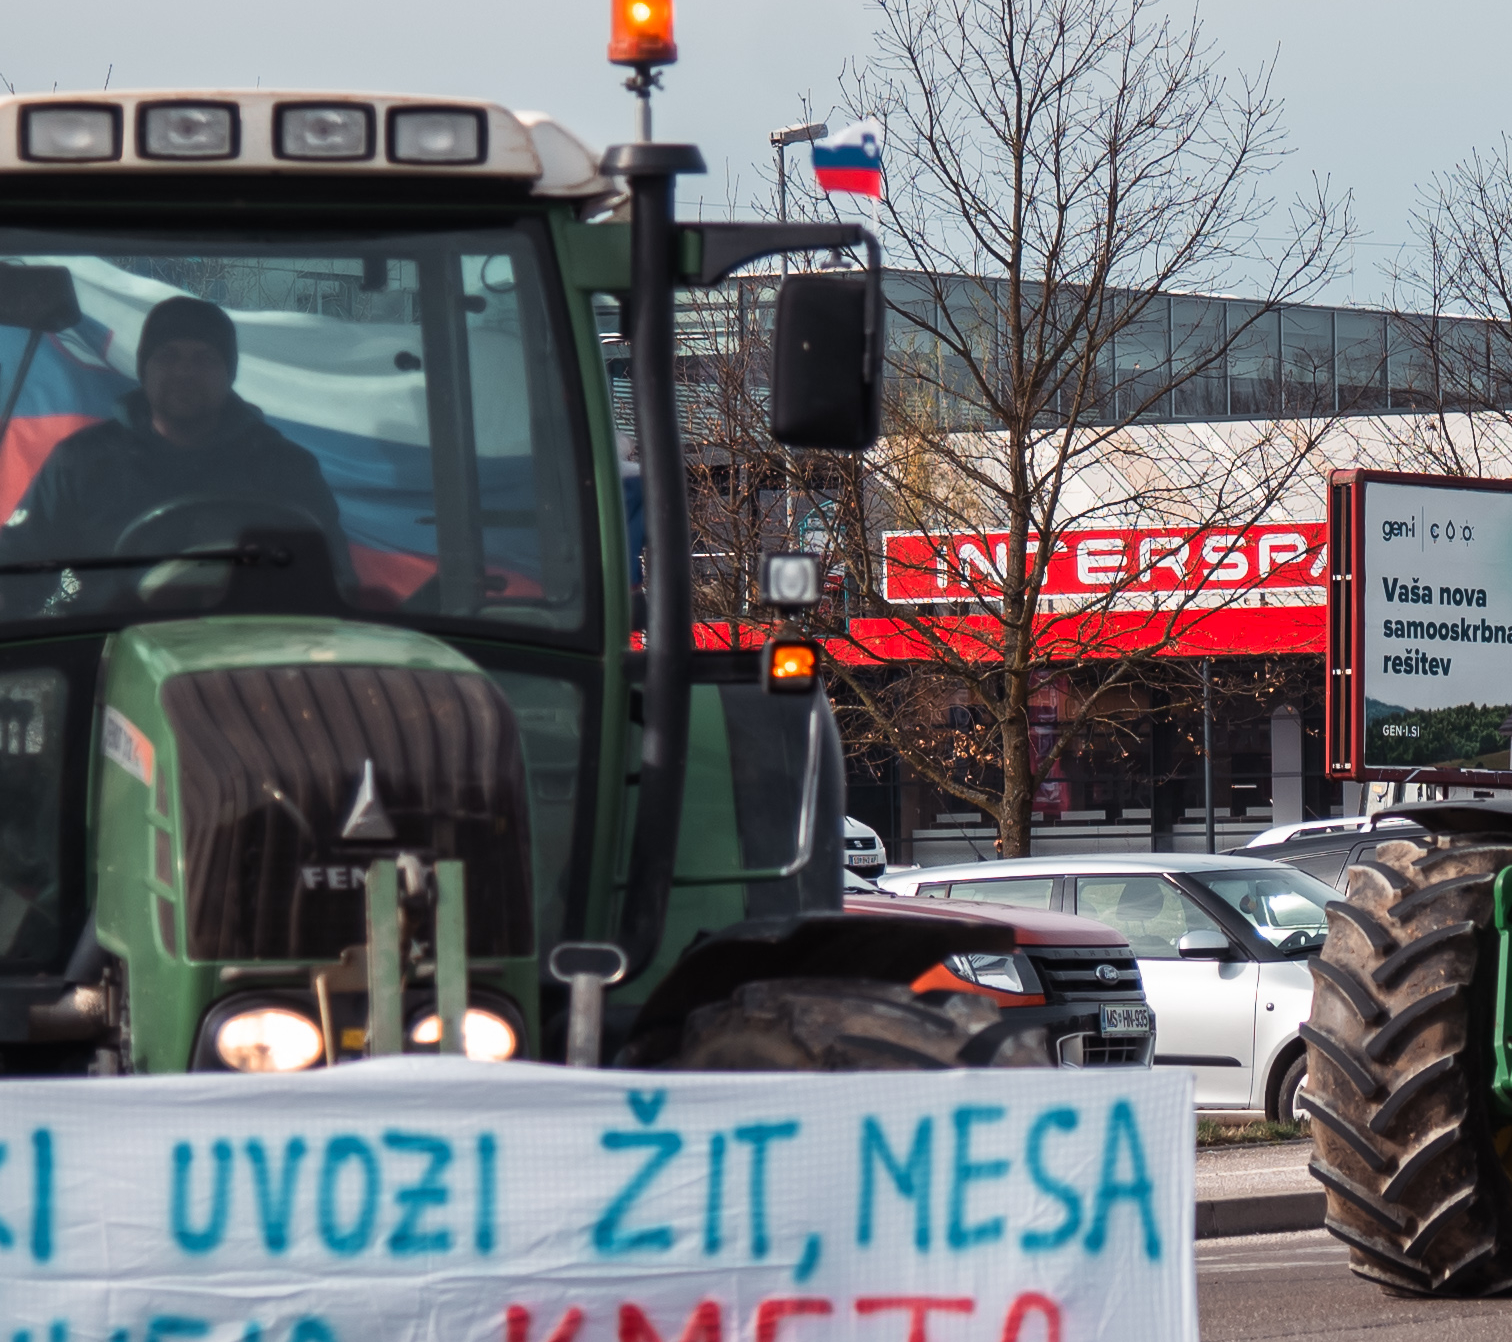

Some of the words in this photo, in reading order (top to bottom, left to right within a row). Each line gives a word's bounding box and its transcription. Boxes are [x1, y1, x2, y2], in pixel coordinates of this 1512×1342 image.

[937, 532, 1326, 589] INTERSP
[1382, 576, 1433, 605] Vaša
[1440, 586, 1487, 607] nova
[1383, 648, 1452, 677] rešitev
[1106, 1009, 1118, 1028] MS
[1122, 1009, 1148, 1028] HN-935
[169, 1129, 500, 1259] UVOZI
[588, 1089, 825, 1283] ŽIT,
[855, 1096, 1164, 1262] MESA
